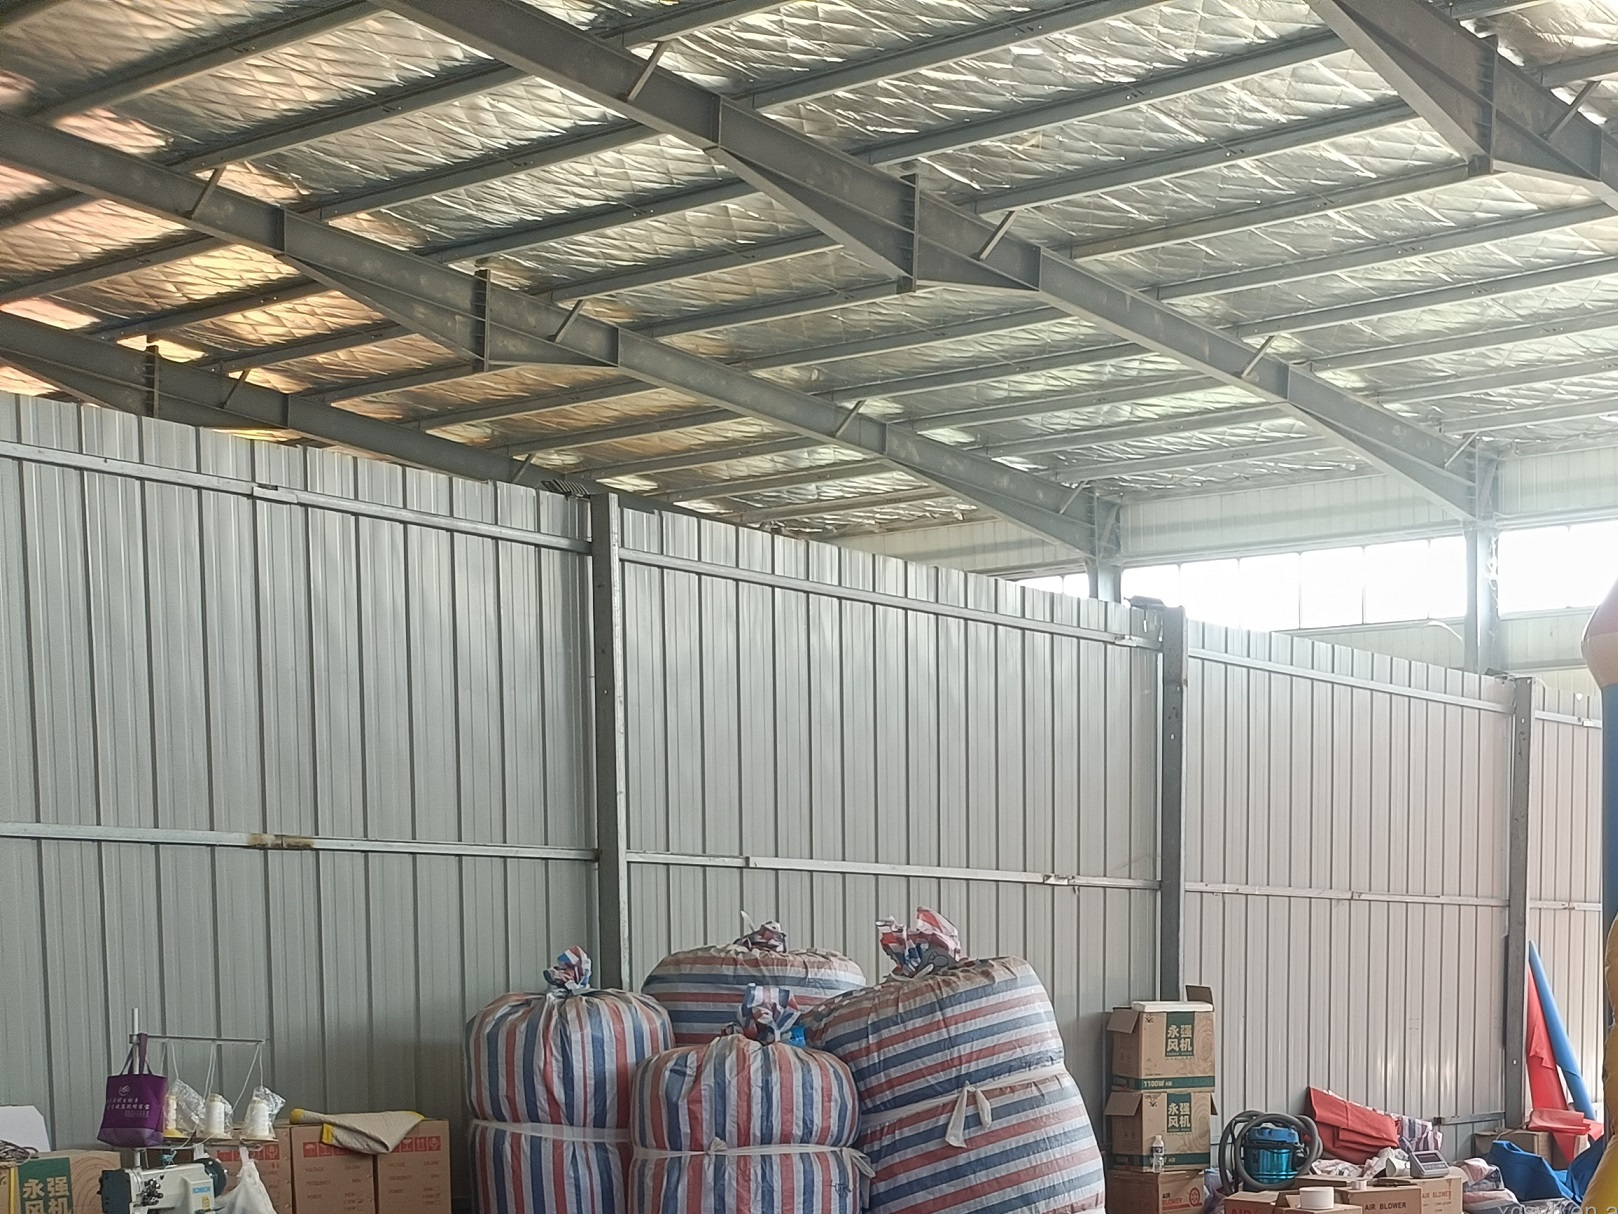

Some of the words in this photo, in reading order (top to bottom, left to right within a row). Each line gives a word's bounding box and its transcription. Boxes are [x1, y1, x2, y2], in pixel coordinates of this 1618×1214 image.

[1167, 1024, 1192, 1038] 永强
[1167, 1038, 1192, 1051] 风机
[1168, 1102, 1191, 1115] 永强
[1168, 1115, 1191, 1128] 风机
[23, 1176, 69, 1199] 永强
[1380, 1202, 1407, 1210] BLOWER
